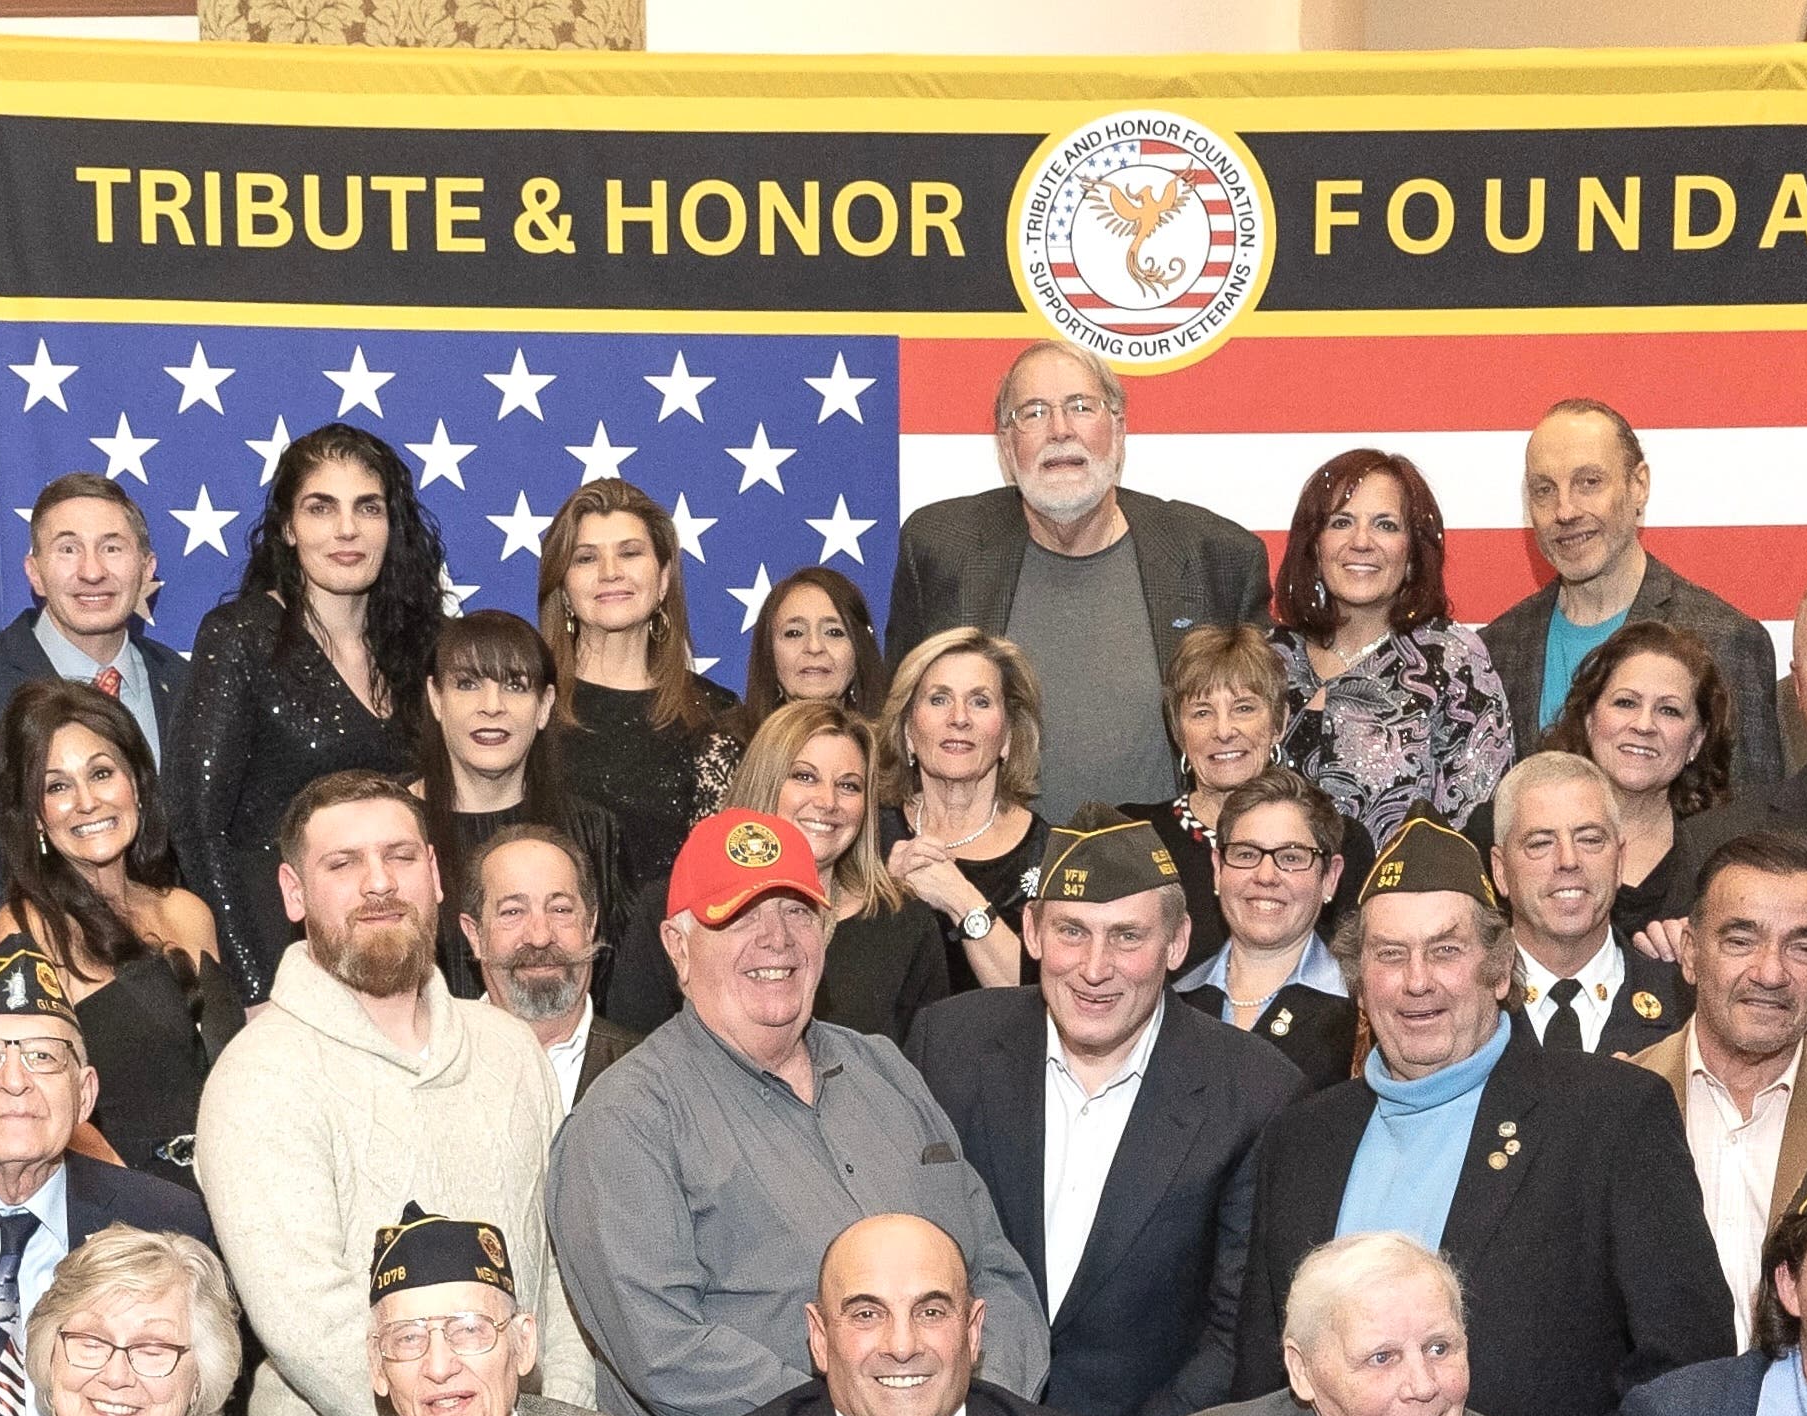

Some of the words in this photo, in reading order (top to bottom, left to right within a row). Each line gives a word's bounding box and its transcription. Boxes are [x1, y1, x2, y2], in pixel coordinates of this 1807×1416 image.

[1026, 161, 1067, 245] TRIBUTE
[1064, 131, 1103, 166] AND
[1105, 119, 1182, 142] HONOR
[1183, 130, 1255, 248] FOUNDATION
[76, 168, 485, 252] TRIBUTE
[515, 178, 575, 254] &
[607, 180, 964, 257] HONOR
[1029, 261, 1123, 355] SUPPORTING
[1128, 338, 1171, 357] OUR
[1173, 264, 1251, 348] VETERANS
[1064, 869, 1089, 882] VFW
[1381, 861, 1404, 875] VFW
[1063, 884, 1085, 896] 347
[1377, 875, 1401, 888] 347
[378, 1266, 407, 1289] 1078
